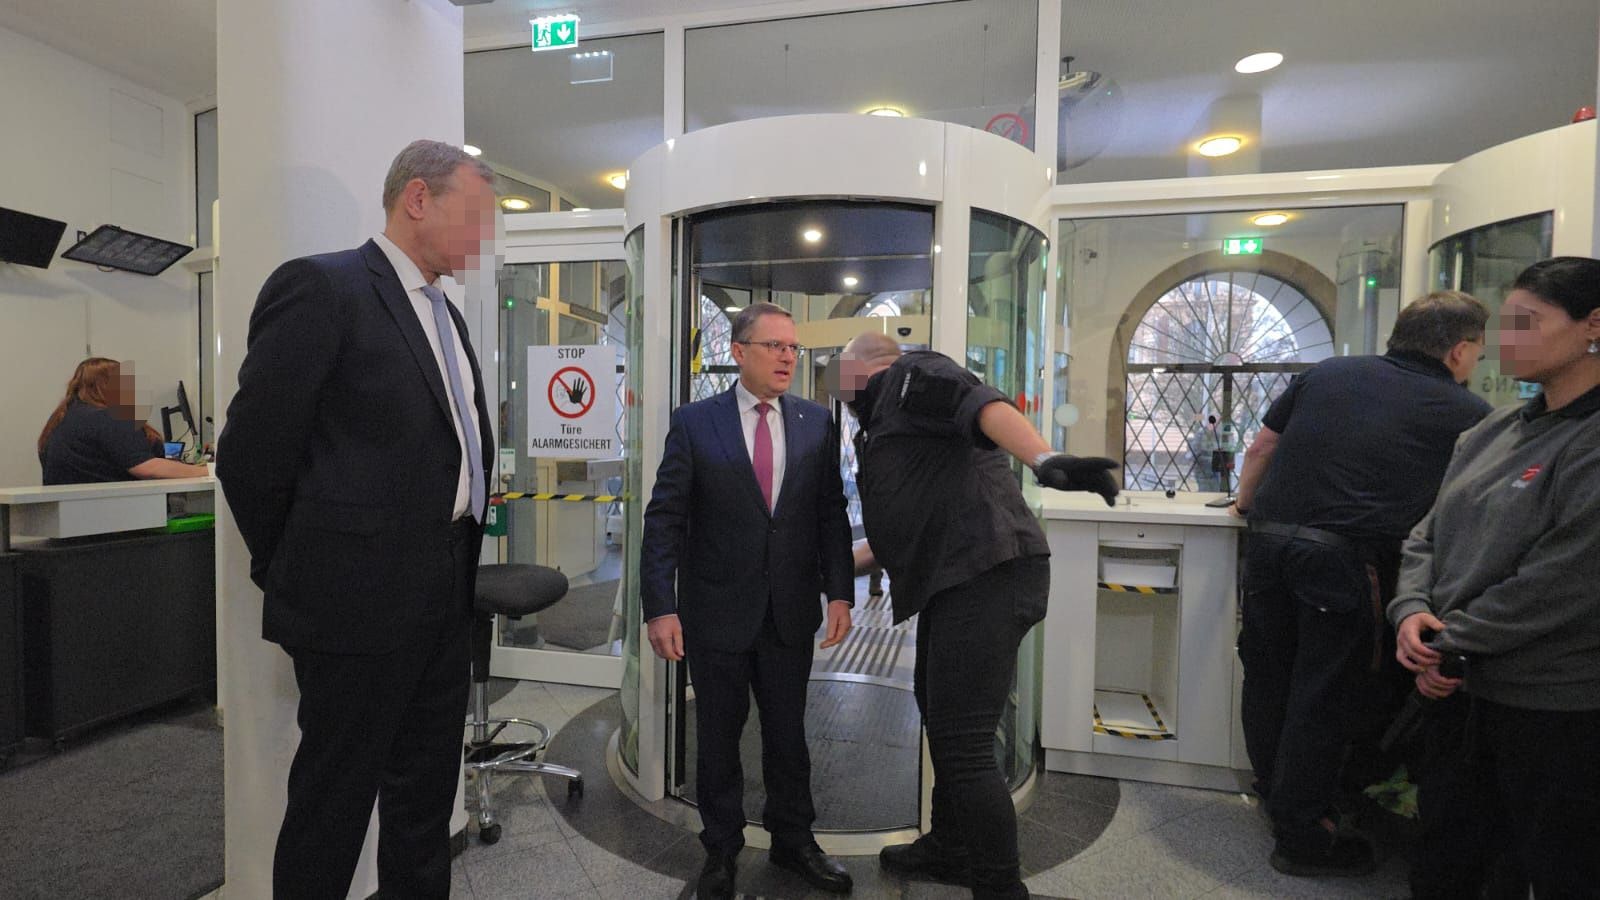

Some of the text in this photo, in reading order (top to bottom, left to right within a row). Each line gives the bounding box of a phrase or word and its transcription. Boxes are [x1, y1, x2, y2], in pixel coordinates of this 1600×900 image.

[558, 348, 585, 359] STOP
[560, 423, 582, 435] Türe
[532, 438, 612, 450] ALARMGESICHERT
